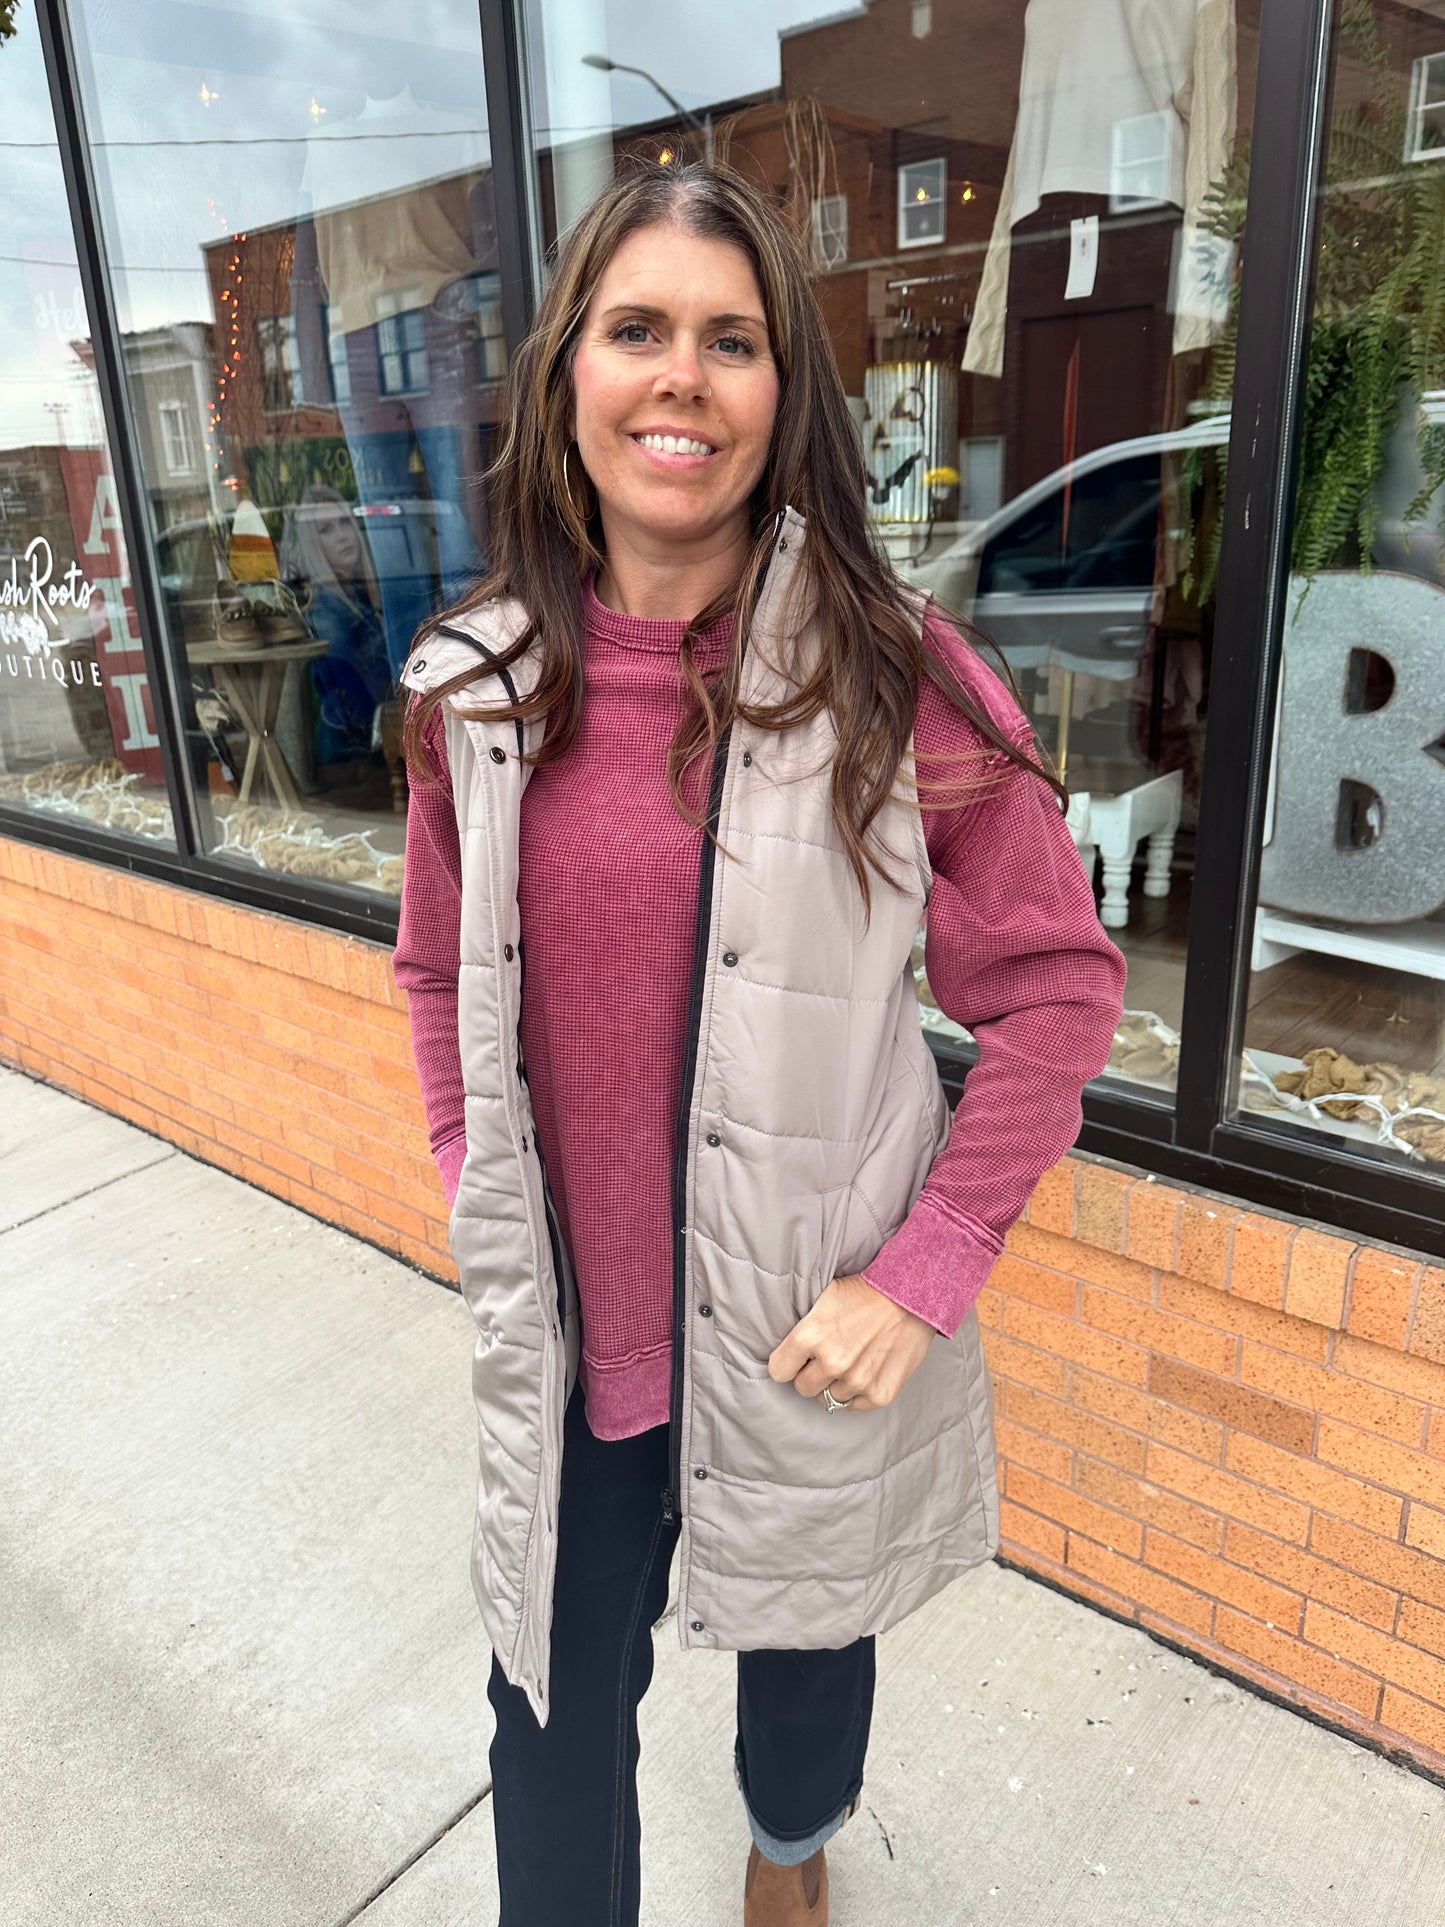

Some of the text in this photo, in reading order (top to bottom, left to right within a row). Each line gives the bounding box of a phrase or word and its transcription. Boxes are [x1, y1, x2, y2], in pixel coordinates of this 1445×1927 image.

[0, 556, 31, 608] sh
[0, 653, 103, 688] UTIQUE
[1258, 568, 1445, 925] B
